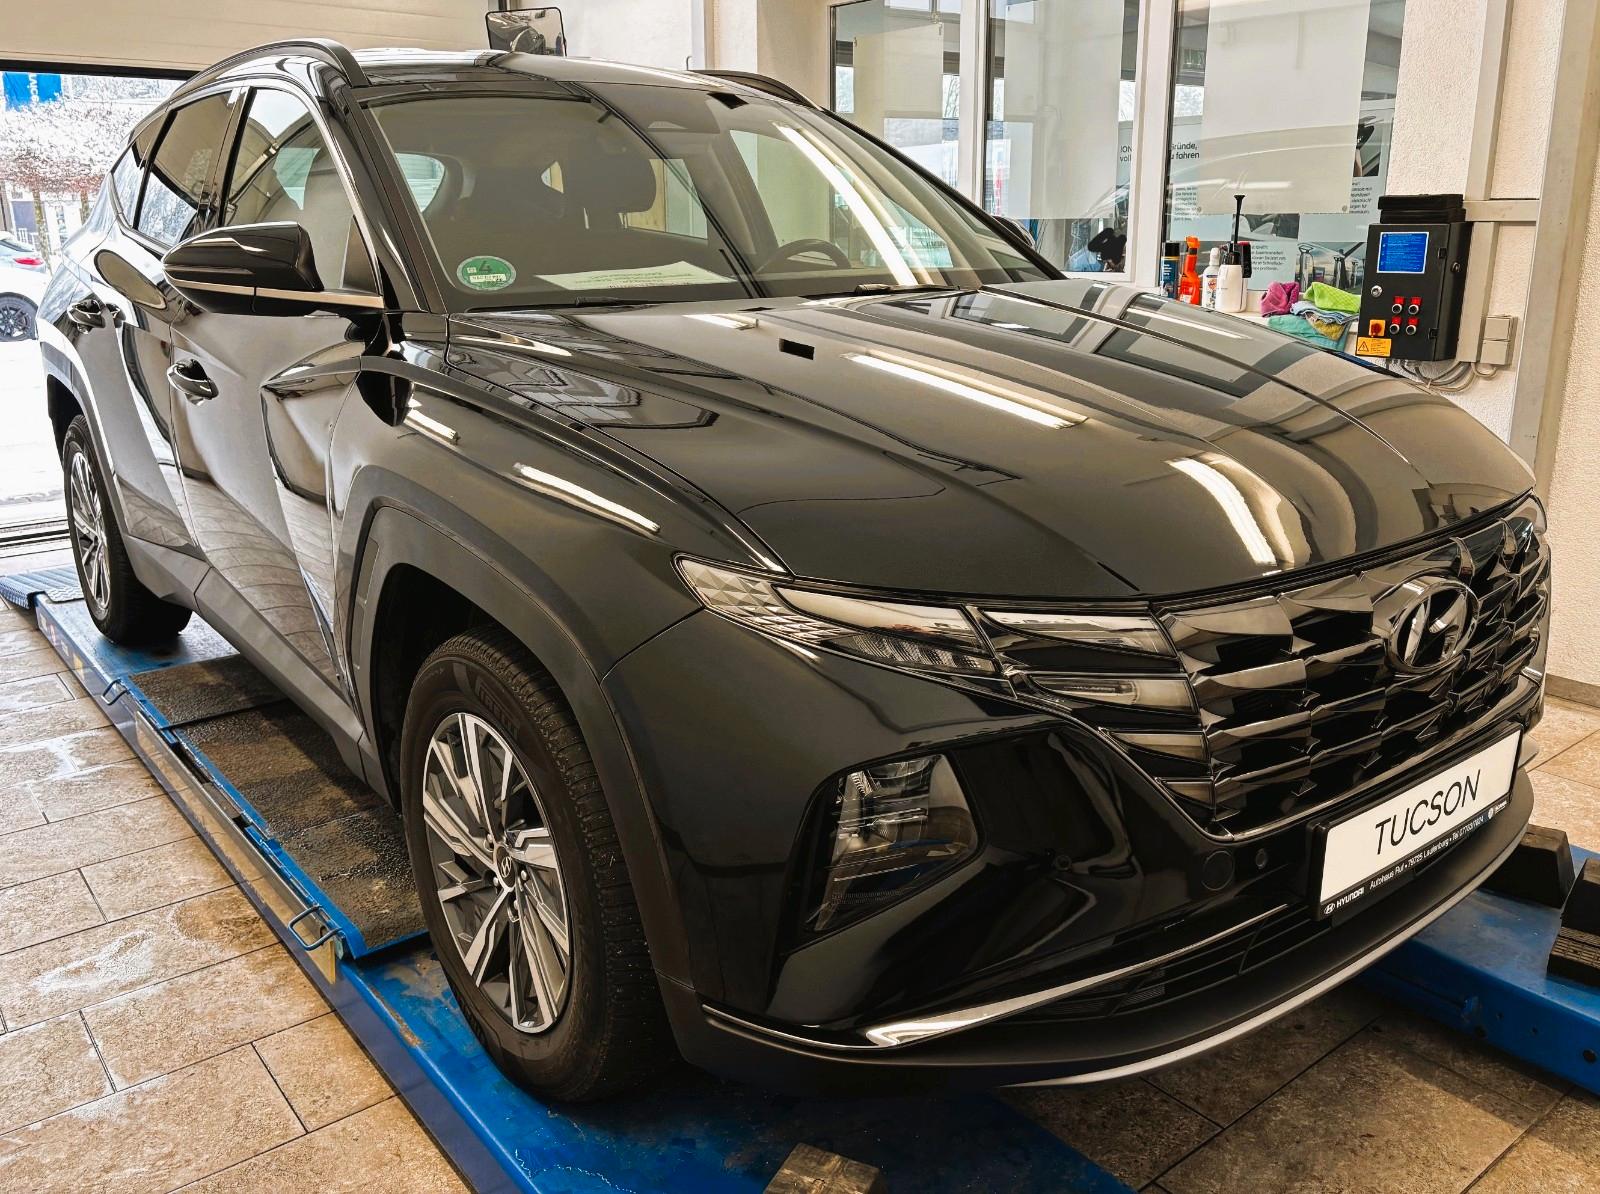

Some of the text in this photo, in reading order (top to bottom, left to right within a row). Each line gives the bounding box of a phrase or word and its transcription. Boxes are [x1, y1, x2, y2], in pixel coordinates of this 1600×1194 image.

[1175, 151, 1200, 160] fahren
[1375, 769, 1481, 855] TUCSON
[1337, 887, 1364, 908] HYUNDAI
[1369, 871, 1395, 890] Autohaus
